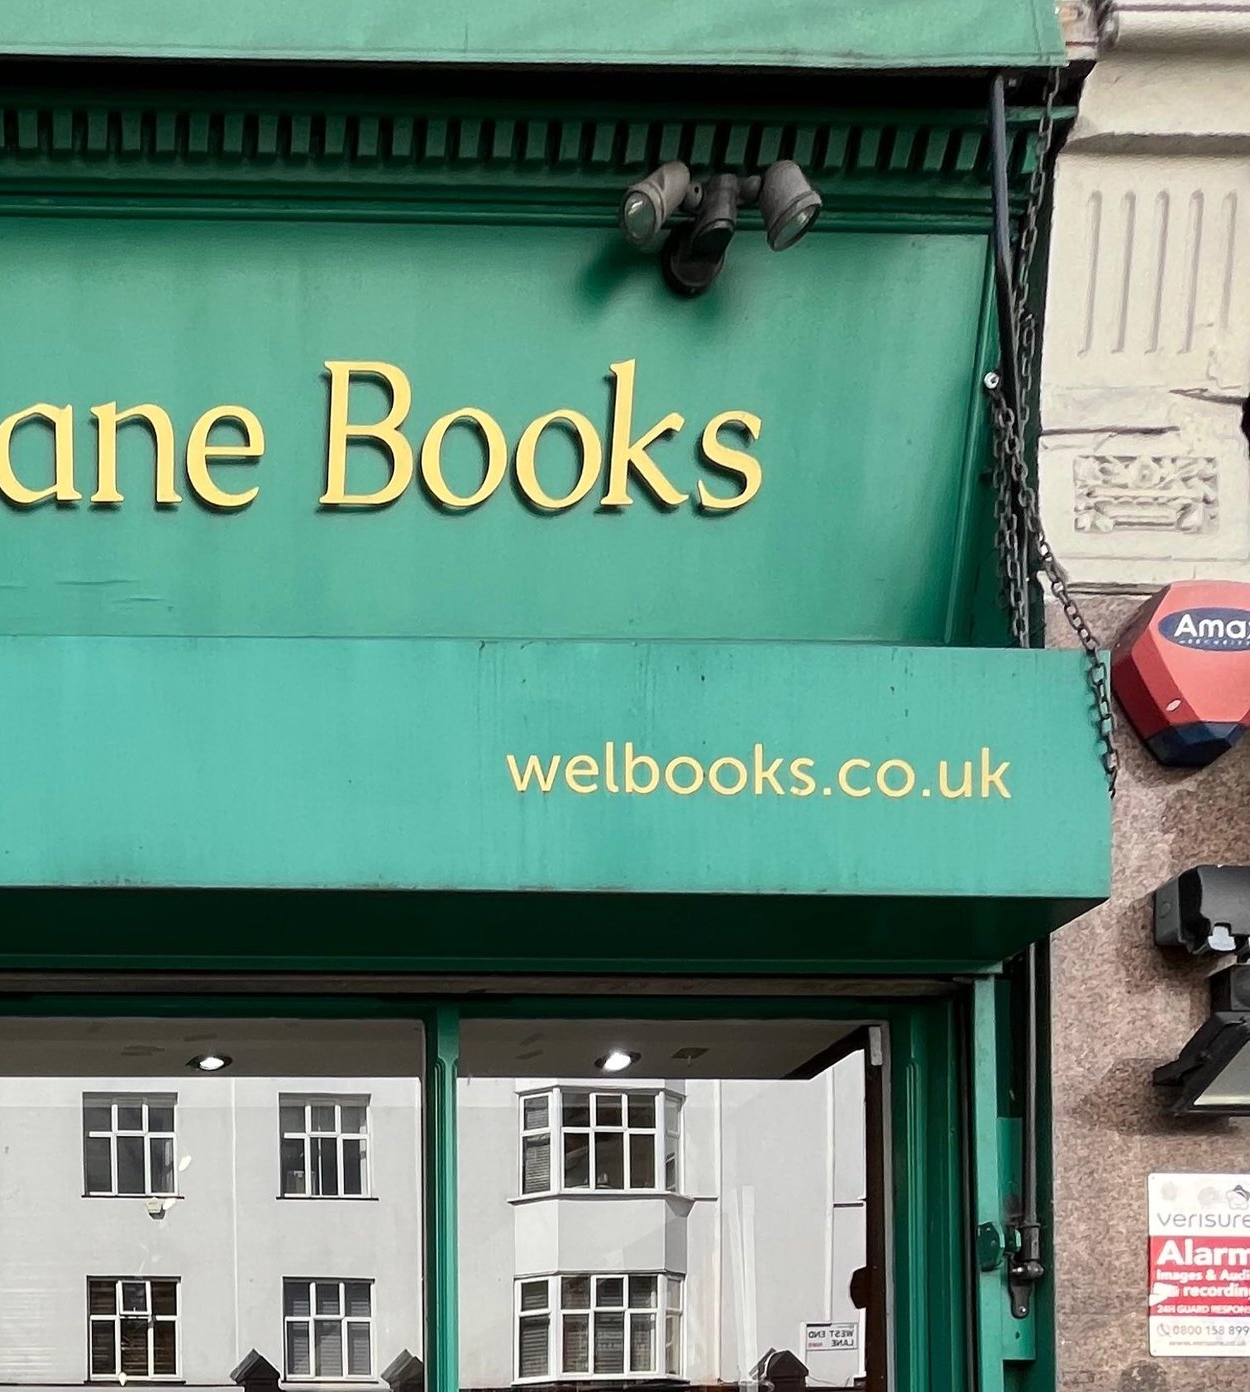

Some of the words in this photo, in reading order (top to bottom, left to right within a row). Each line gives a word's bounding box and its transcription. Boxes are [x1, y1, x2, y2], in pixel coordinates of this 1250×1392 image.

[319, 359, 764, 511] Books
[1174, 613, 1250, 639] Ama
[506, 740, 1012, 800] welbooks.co.uk
[1157, 1213, 1250, 1228] verisure
[1156, 1269, 1203, 1283] Images
[1205, 1269, 1216, 1281] &
[1183, 1283, 1250, 1298] recordin
[1172, 1325, 1202, 1335] 0800
[1205, 1325, 1225, 1335] 158
